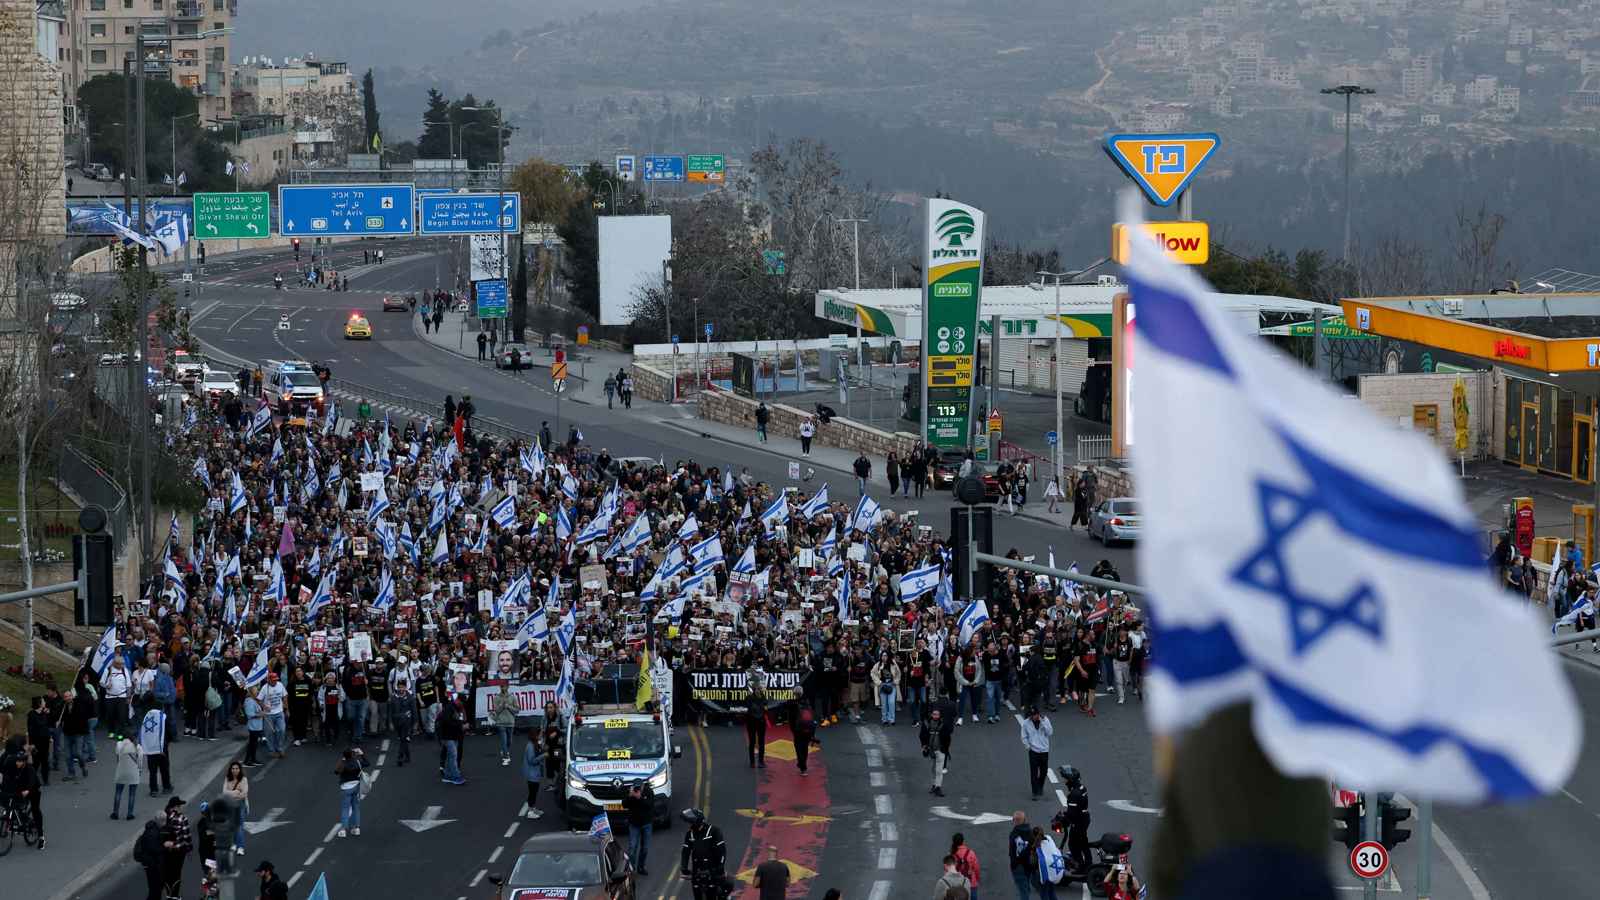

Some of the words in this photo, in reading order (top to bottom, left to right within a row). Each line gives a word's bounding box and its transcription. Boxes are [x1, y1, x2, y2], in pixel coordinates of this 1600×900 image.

[1141, 144, 1186, 174] פז
[932, 248, 958, 259] אלון
[938, 285, 969, 294] אלונית
[1002, 319, 1038, 336] דור
[691, 673, 719, 688] ביחד
[764, 673, 800, 688] ישראל
[1360, 852, 1380, 867] 30
